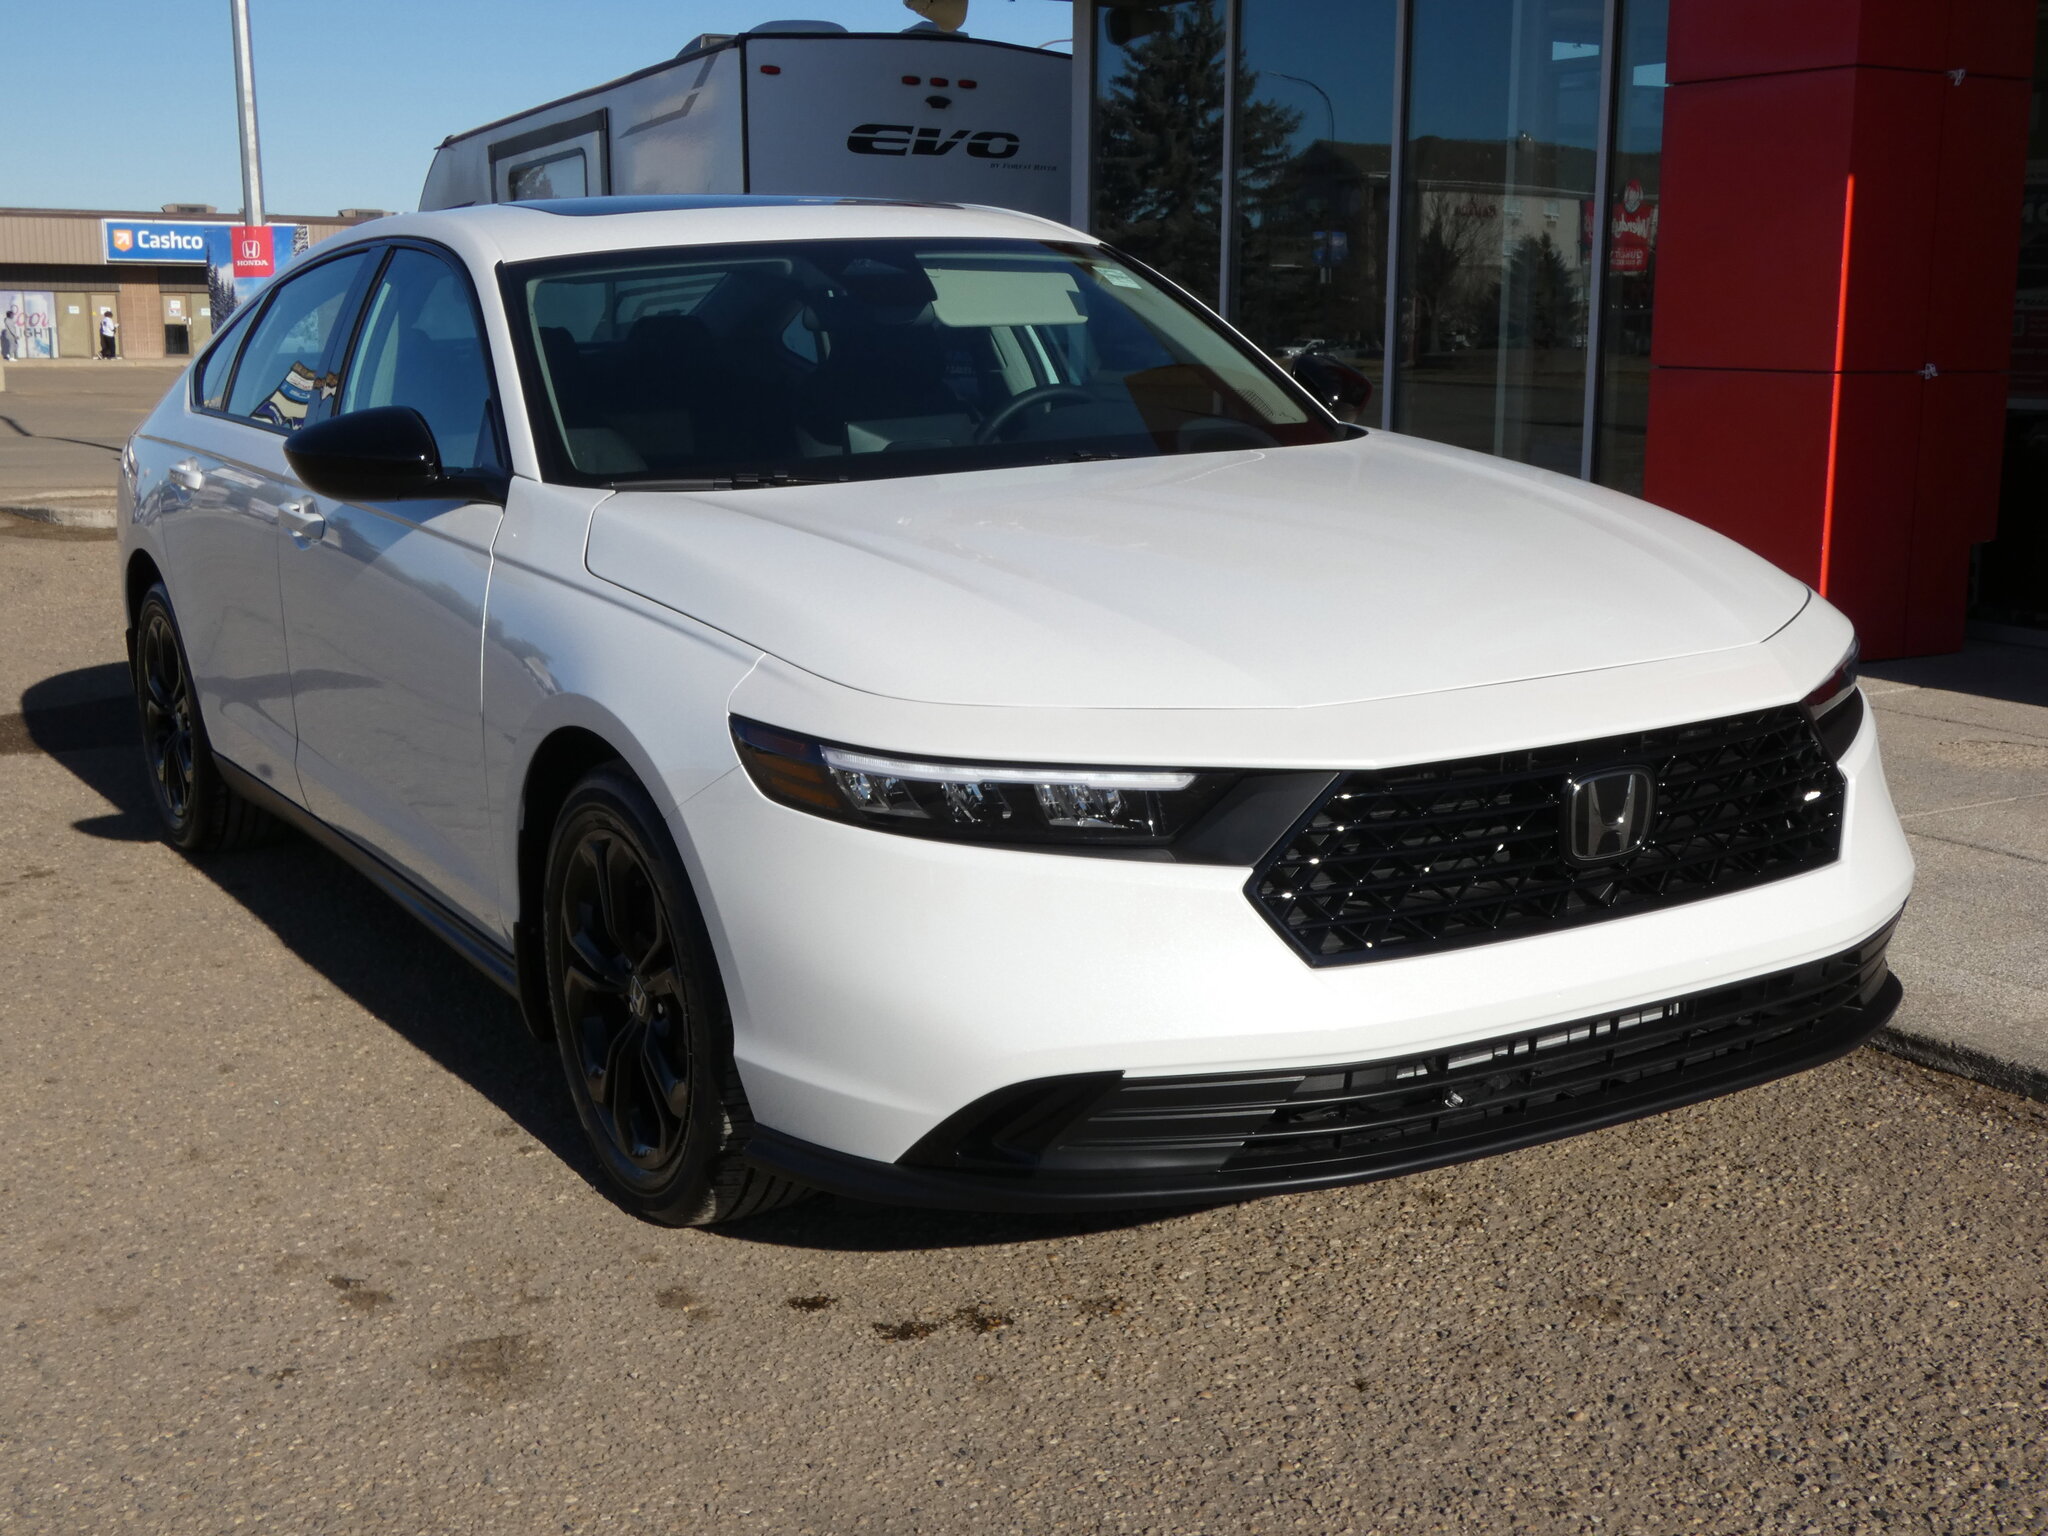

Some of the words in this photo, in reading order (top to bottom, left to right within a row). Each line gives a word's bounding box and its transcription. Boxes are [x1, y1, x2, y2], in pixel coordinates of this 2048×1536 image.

[847, 124, 1020, 159] EVO
[137, 230, 203, 249] Cashco
[236, 259, 269, 267] HONDA
